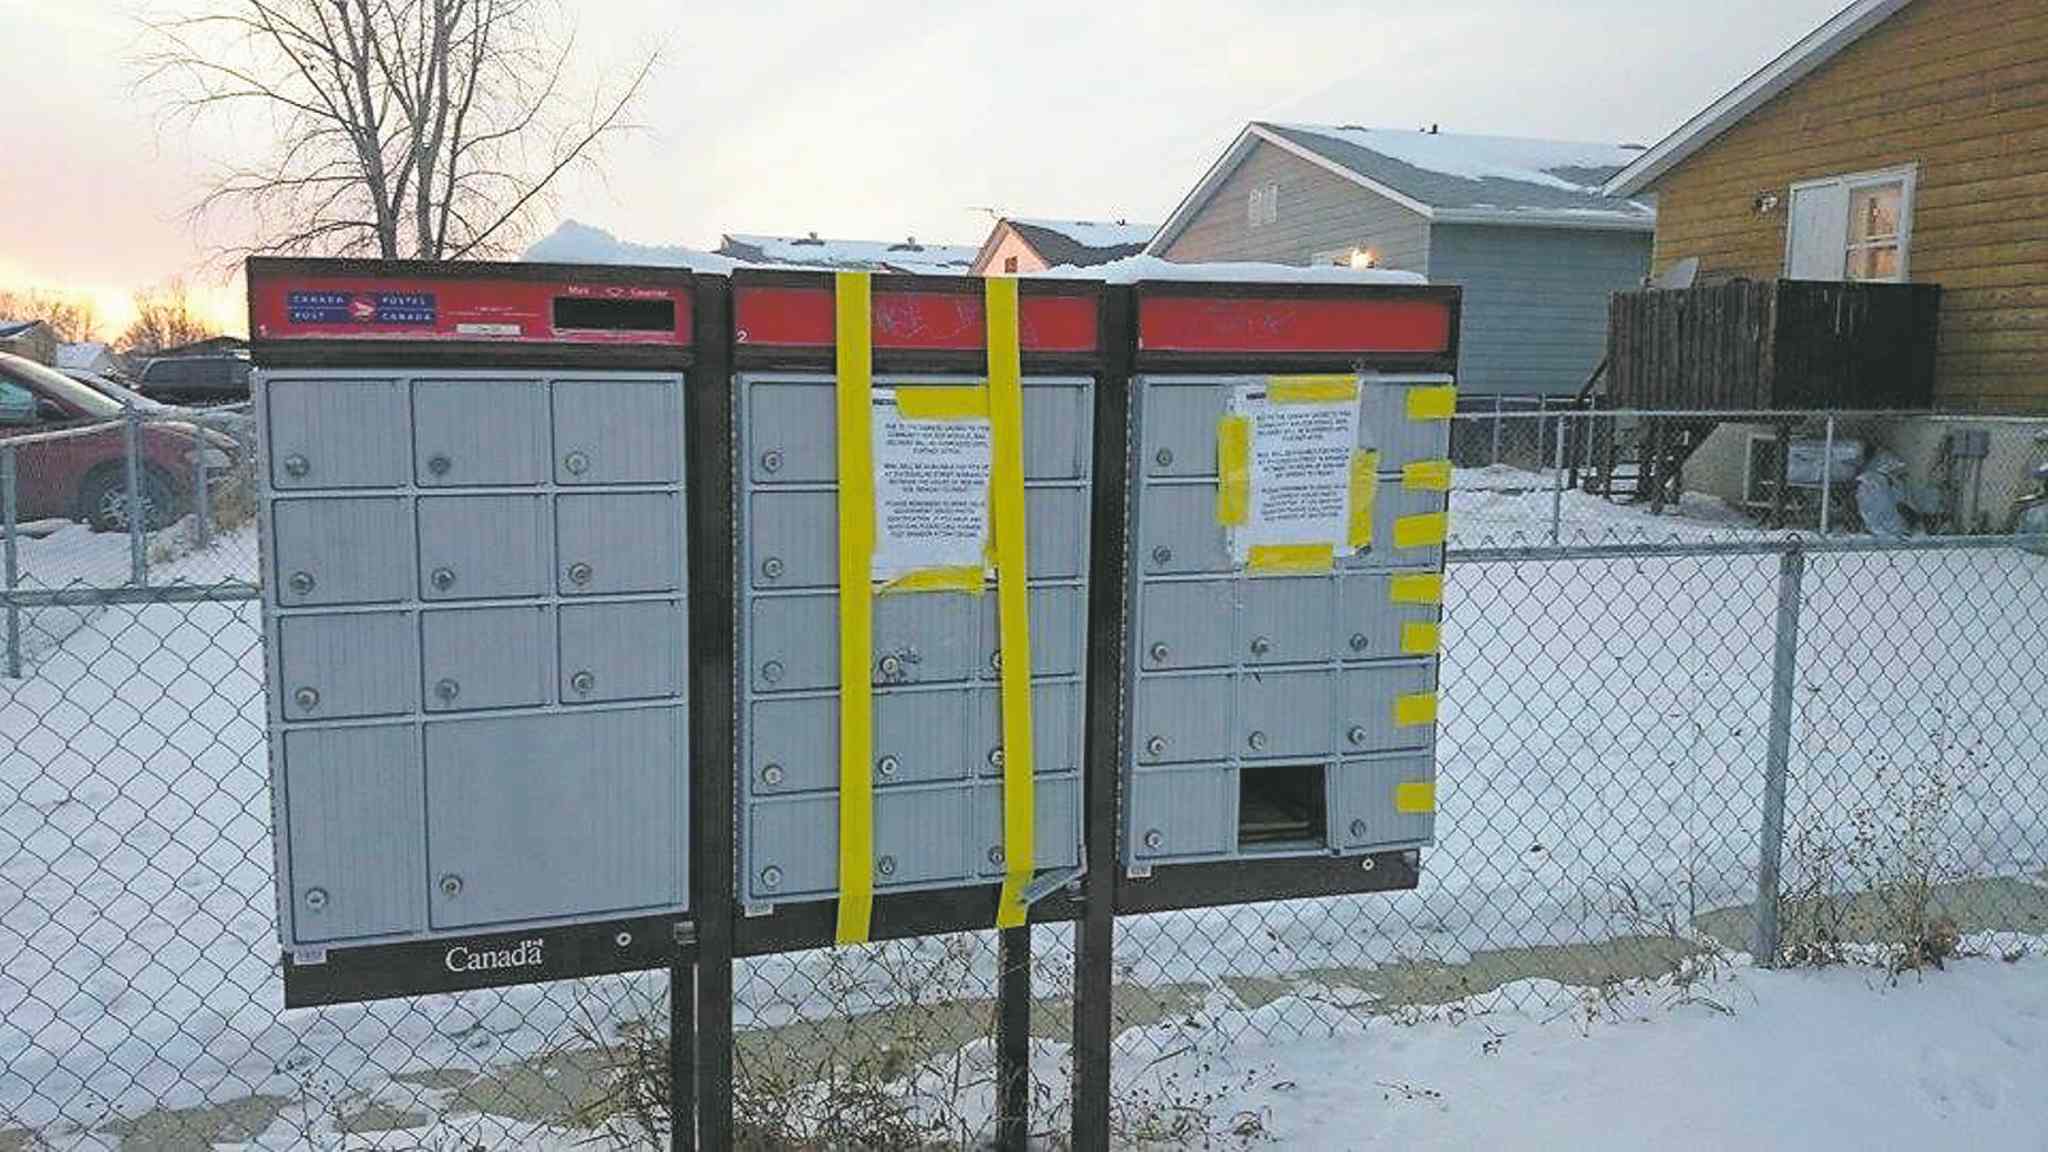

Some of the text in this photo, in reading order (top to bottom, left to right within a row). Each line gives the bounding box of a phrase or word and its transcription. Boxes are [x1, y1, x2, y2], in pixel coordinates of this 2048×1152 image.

[292, 295, 345, 305] CANADA
[381, 296, 427, 306] POSTES
[293, 310, 325, 321] POST
[381, 312, 433, 322] CANADA
[737, 330, 748, 343] 2
[445, 939, 543, 972] Canada
